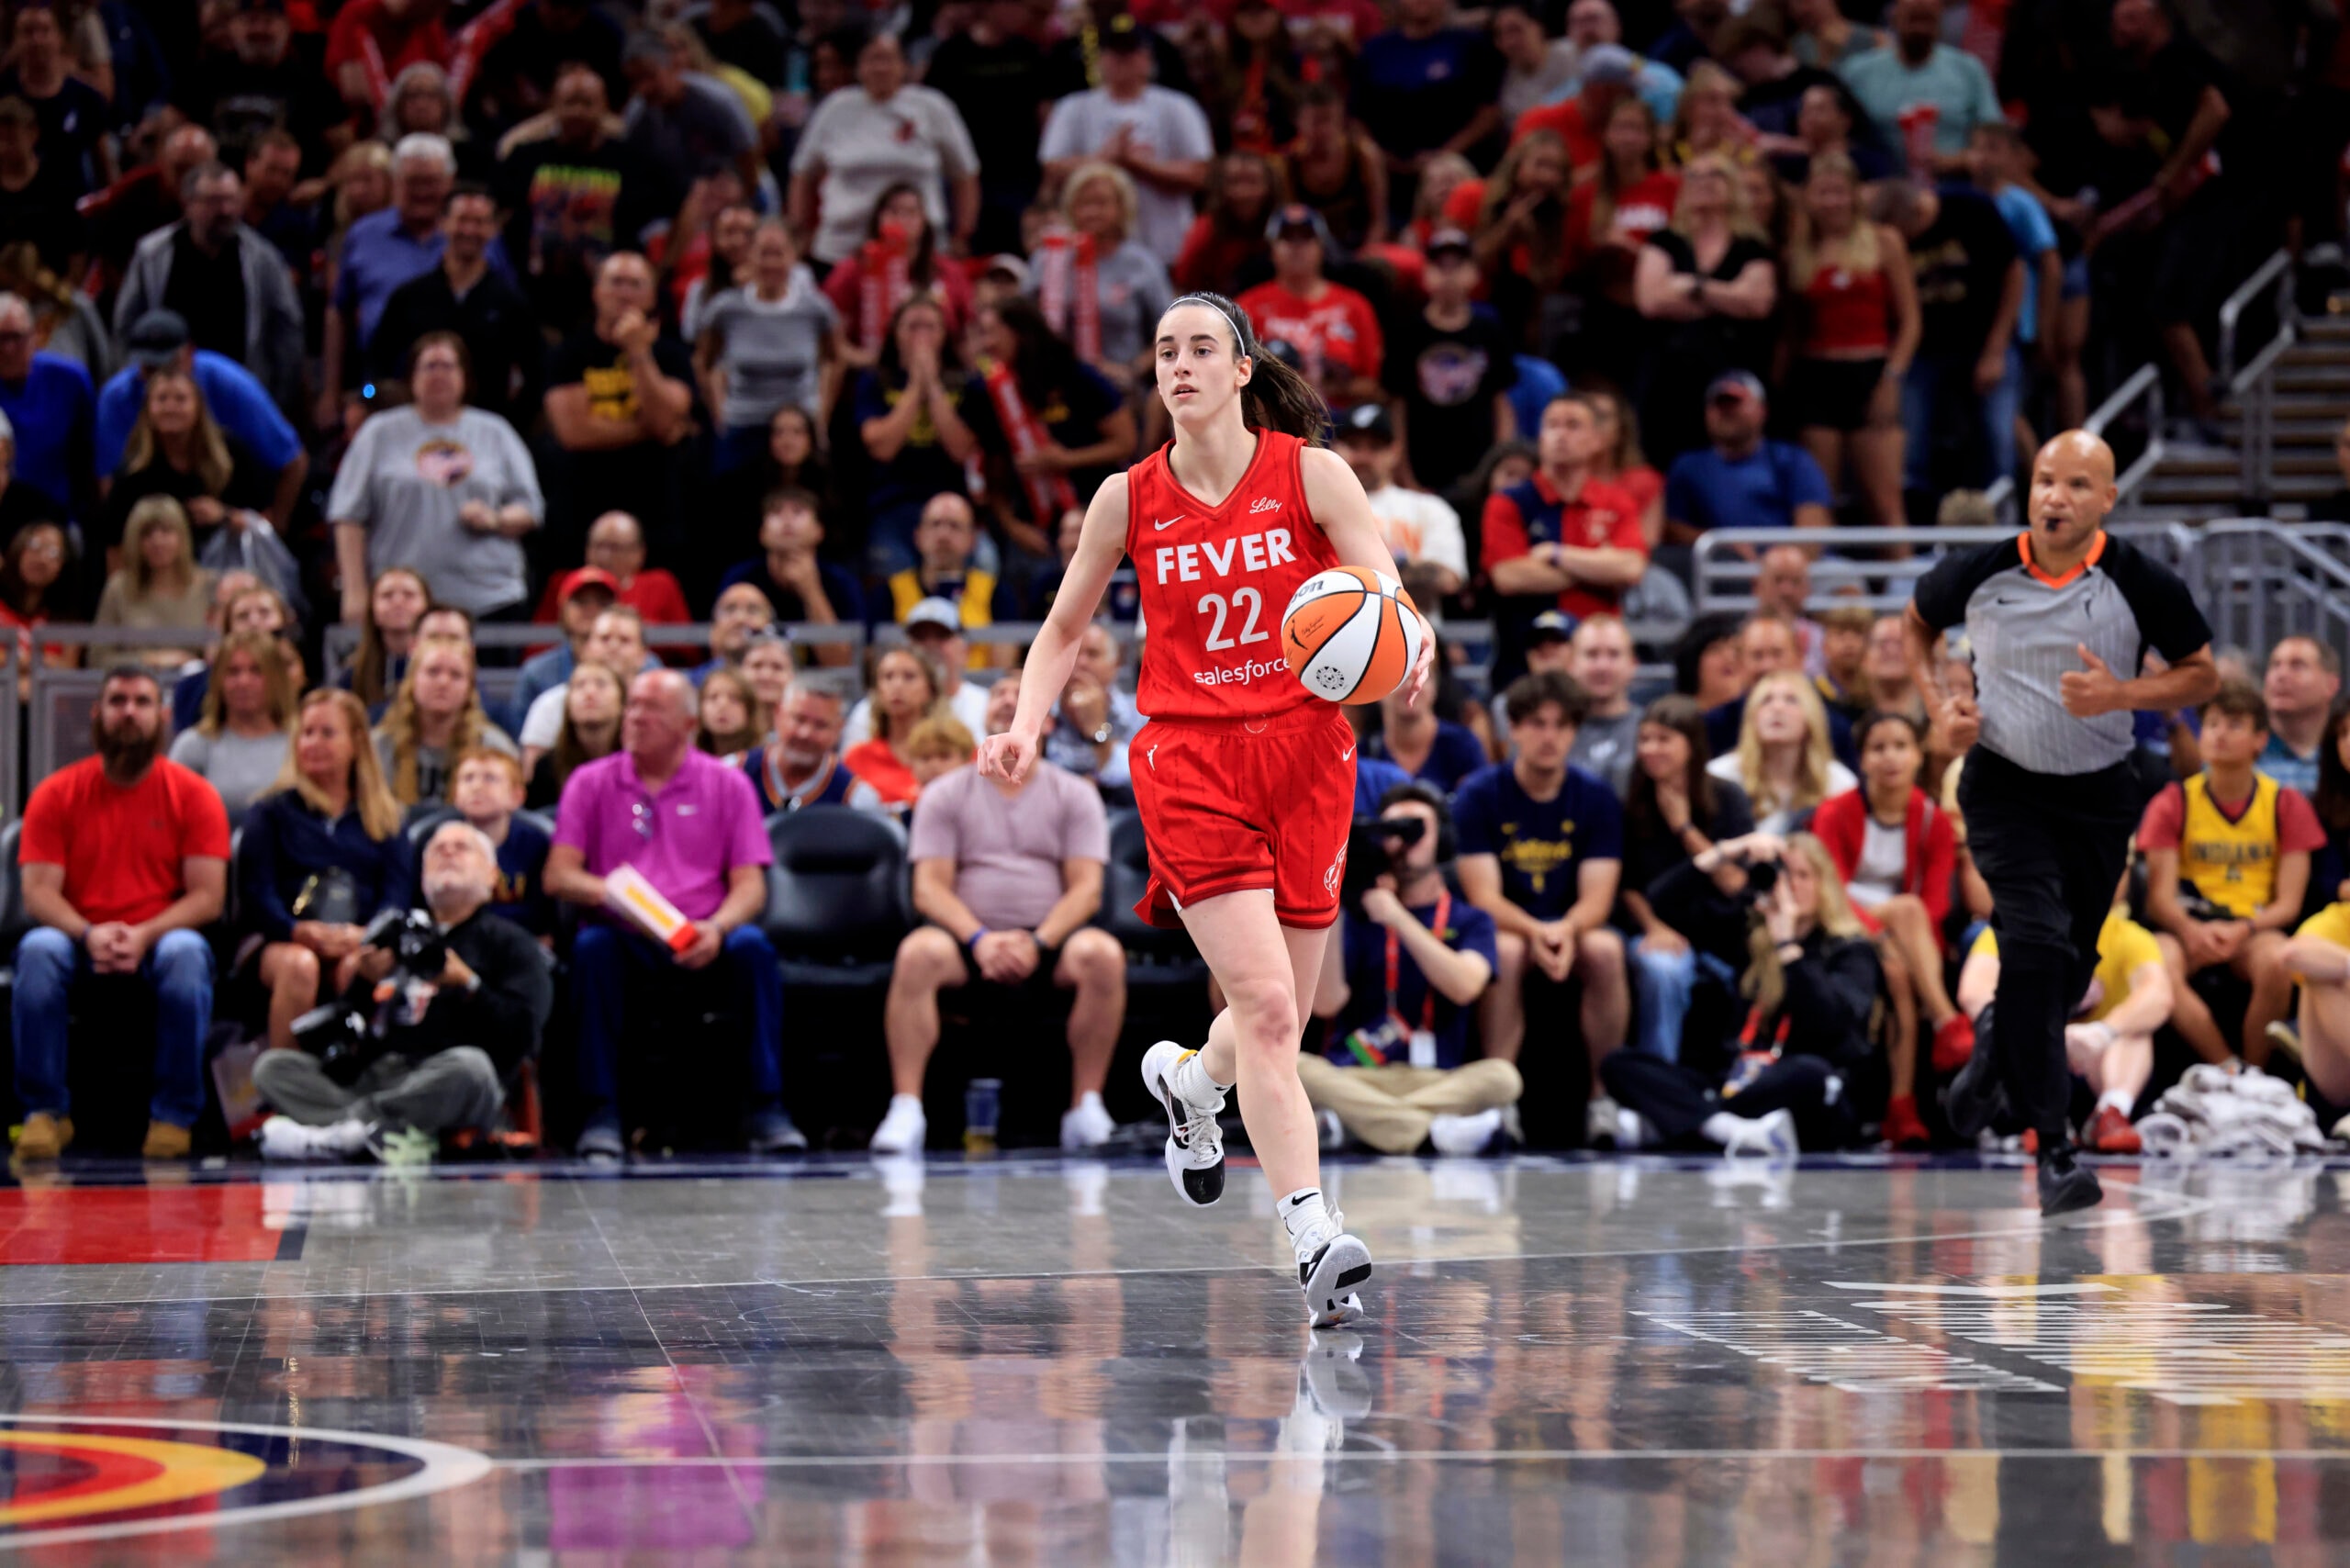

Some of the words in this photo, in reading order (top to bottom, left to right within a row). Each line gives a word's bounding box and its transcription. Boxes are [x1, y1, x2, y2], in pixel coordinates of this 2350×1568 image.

[1249, 496, 1282, 514] Lilly
[1156, 529, 1297, 585] FEVER
[1197, 587, 1270, 653] 22
[1193, 657, 1291, 686] salesforce
